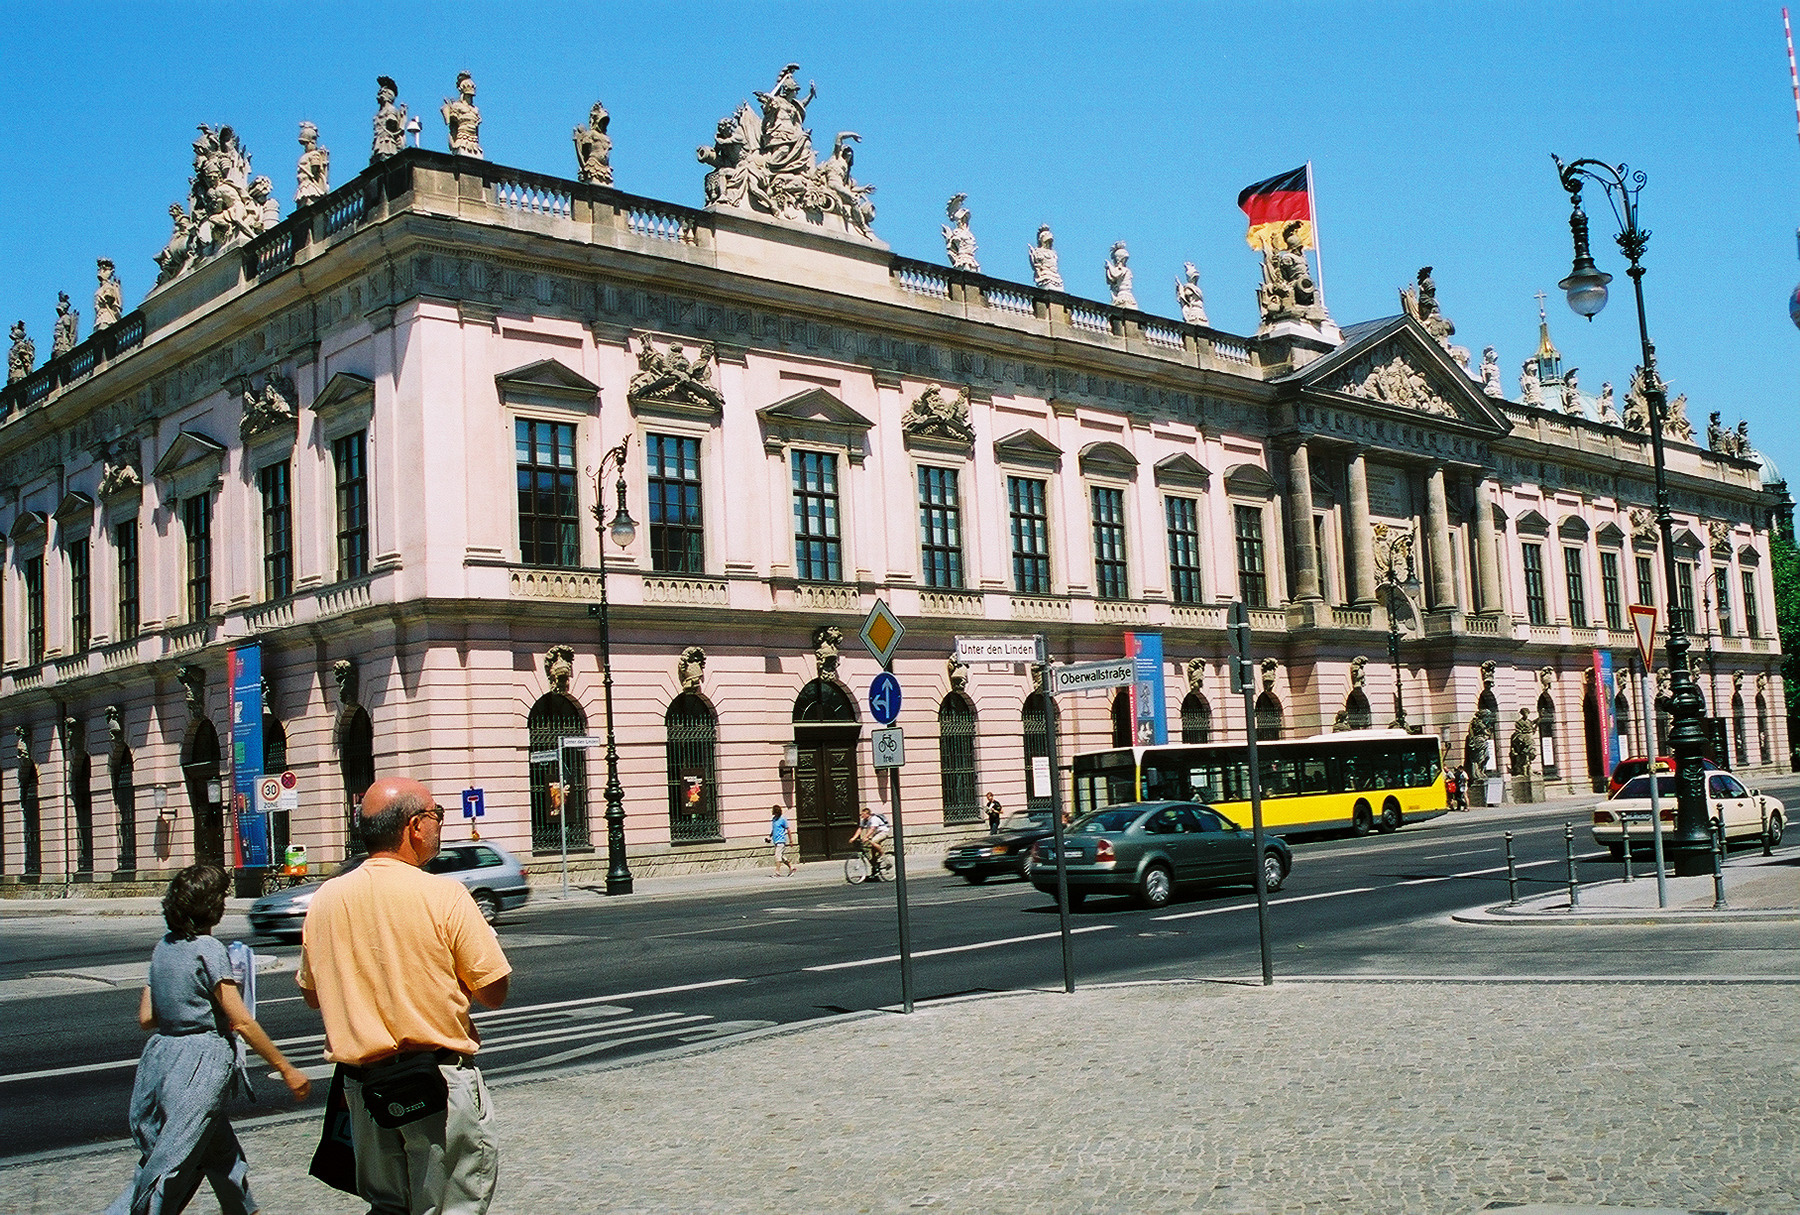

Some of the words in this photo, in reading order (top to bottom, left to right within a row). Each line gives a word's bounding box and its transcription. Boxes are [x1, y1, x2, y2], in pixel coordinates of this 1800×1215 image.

[960, 643, 984, 655] Unter
[986, 643, 1003, 655] den
[1005, 643, 1034, 655] Linden
[1060, 667, 1132, 685] Oberwallstraße
[883, 753, 894, 763] frei
[265, 785, 277, 796] 30
